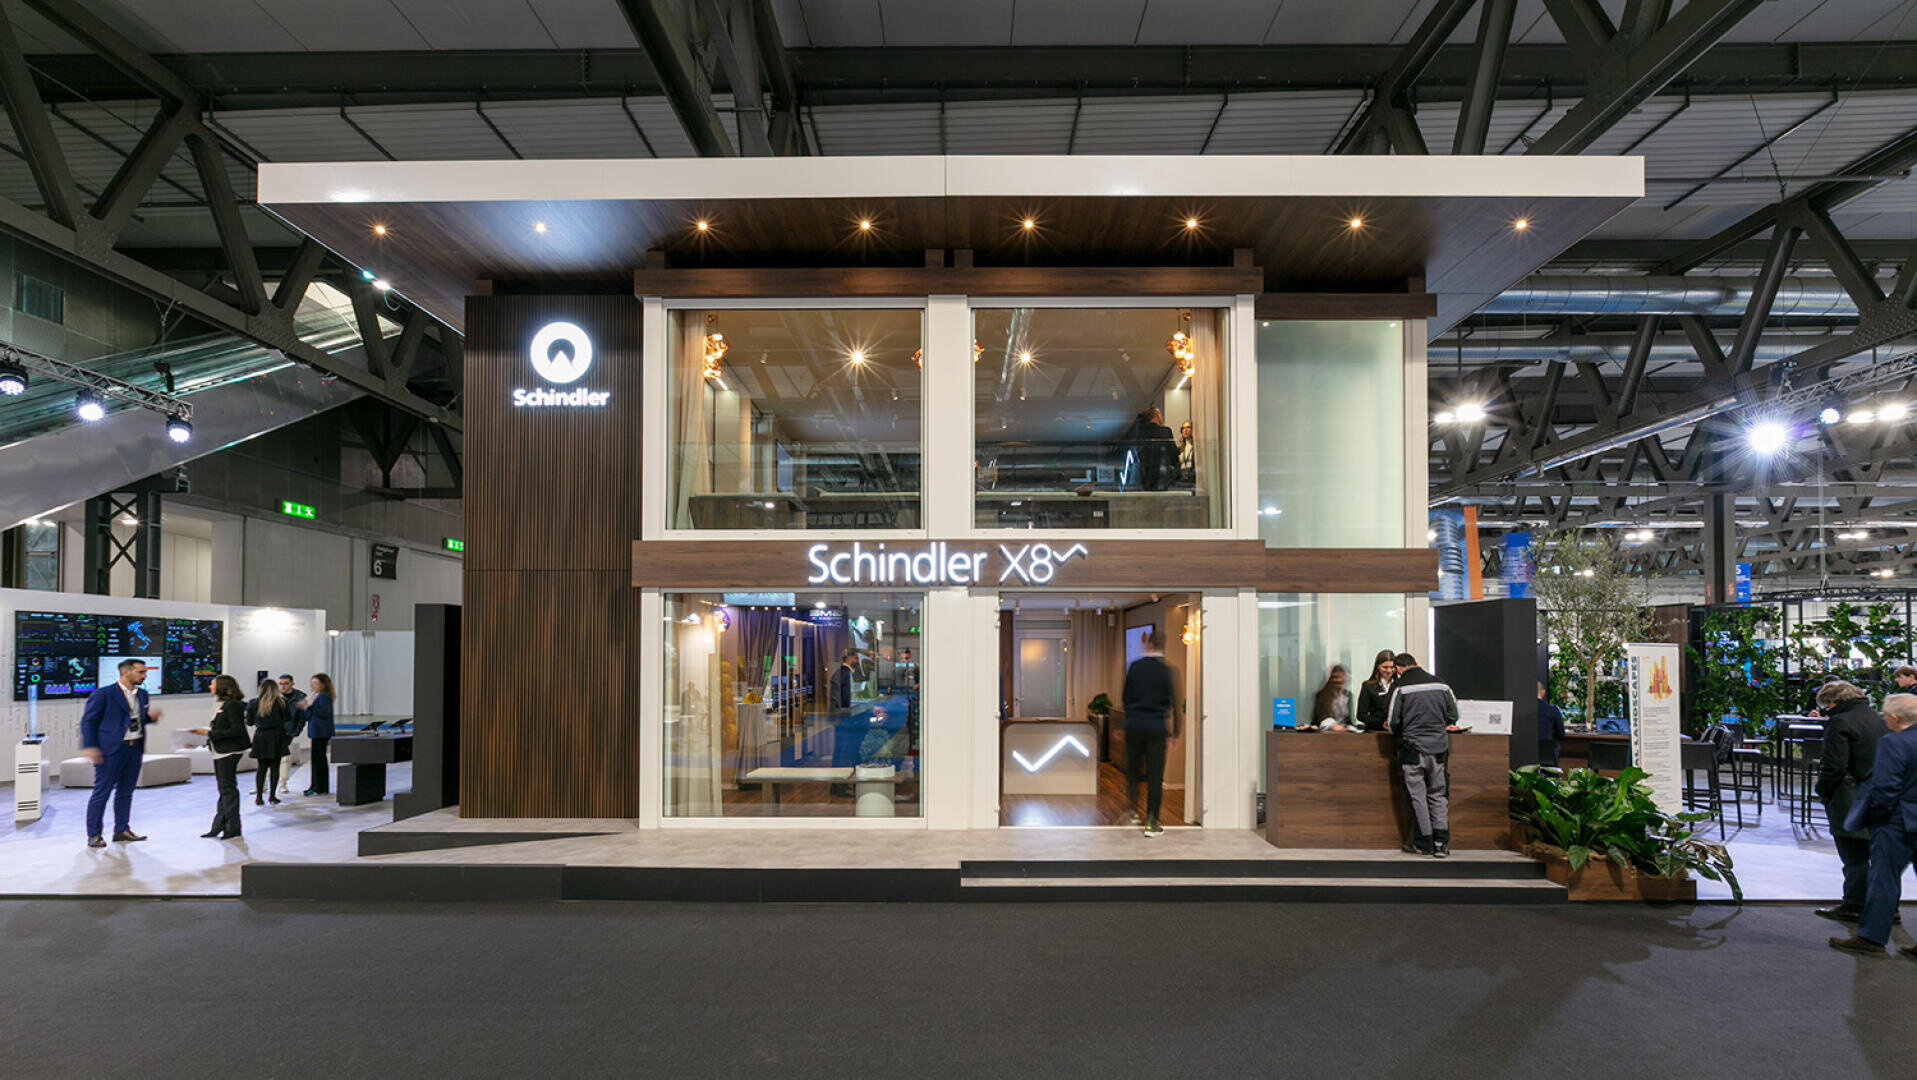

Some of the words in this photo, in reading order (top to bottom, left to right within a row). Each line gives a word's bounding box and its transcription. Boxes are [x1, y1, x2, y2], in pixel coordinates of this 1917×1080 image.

[513, 387, 610, 406] Schindler
[374, 560, 382, 575] 6
[808, 541, 987, 584] Schindler
[1000, 543, 1054, 584] X8
